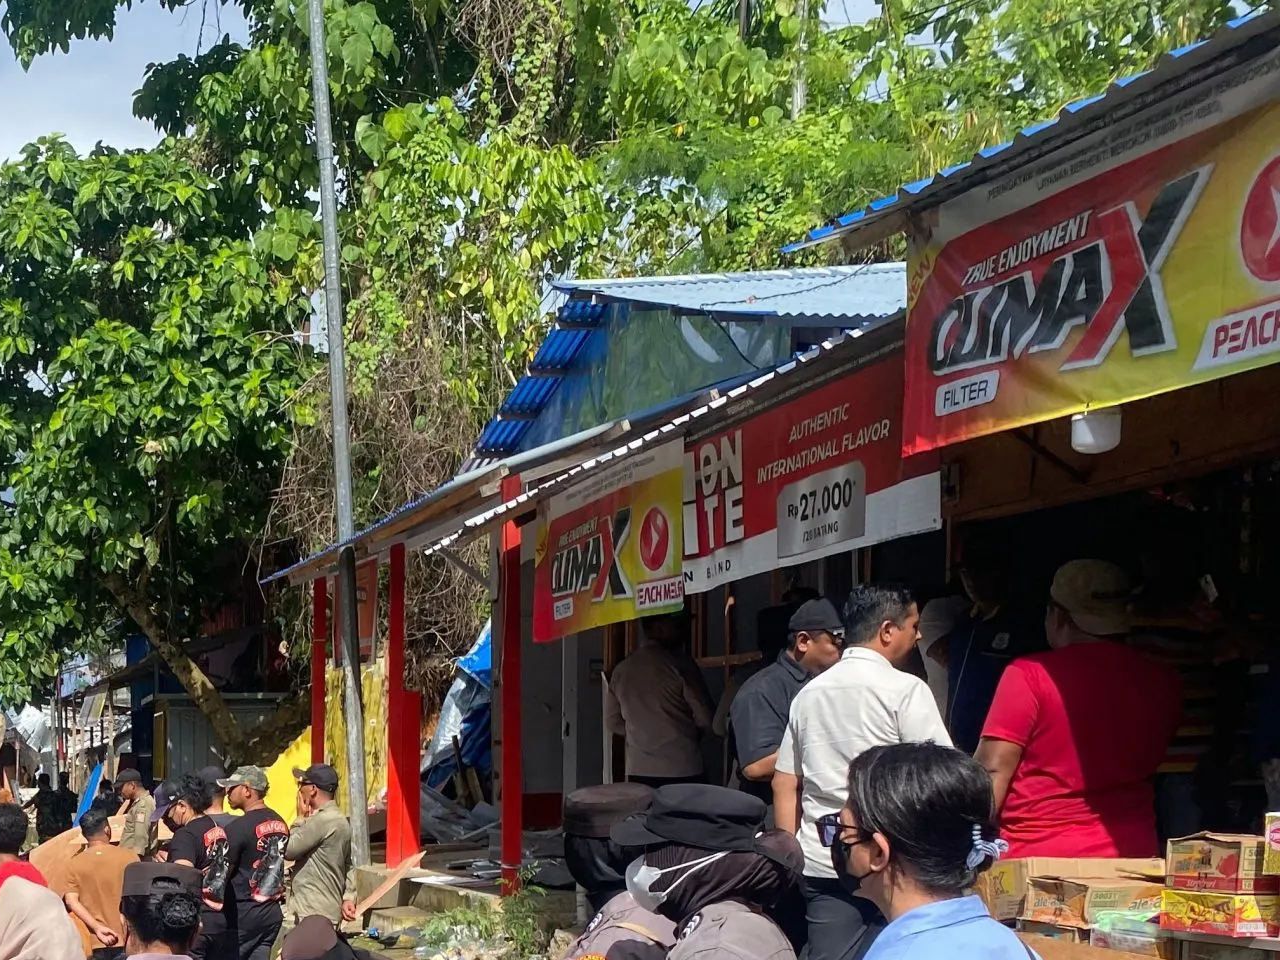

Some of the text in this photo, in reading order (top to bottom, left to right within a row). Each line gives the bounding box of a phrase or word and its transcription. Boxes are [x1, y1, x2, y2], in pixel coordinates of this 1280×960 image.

[961, 209, 1094, 286] TRUE ENJOYMENT
[943, 379, 989, 410] FILTER
[789, 402, 850, 443] AUTHENTIC
[757, 418, 891, 485] INTERNATIONAL FLAVOR
[788, 503, 799, 519] Rp
[551, 507, 635, 602] CLIMAX
[637, 584, 662, 606] EACH
